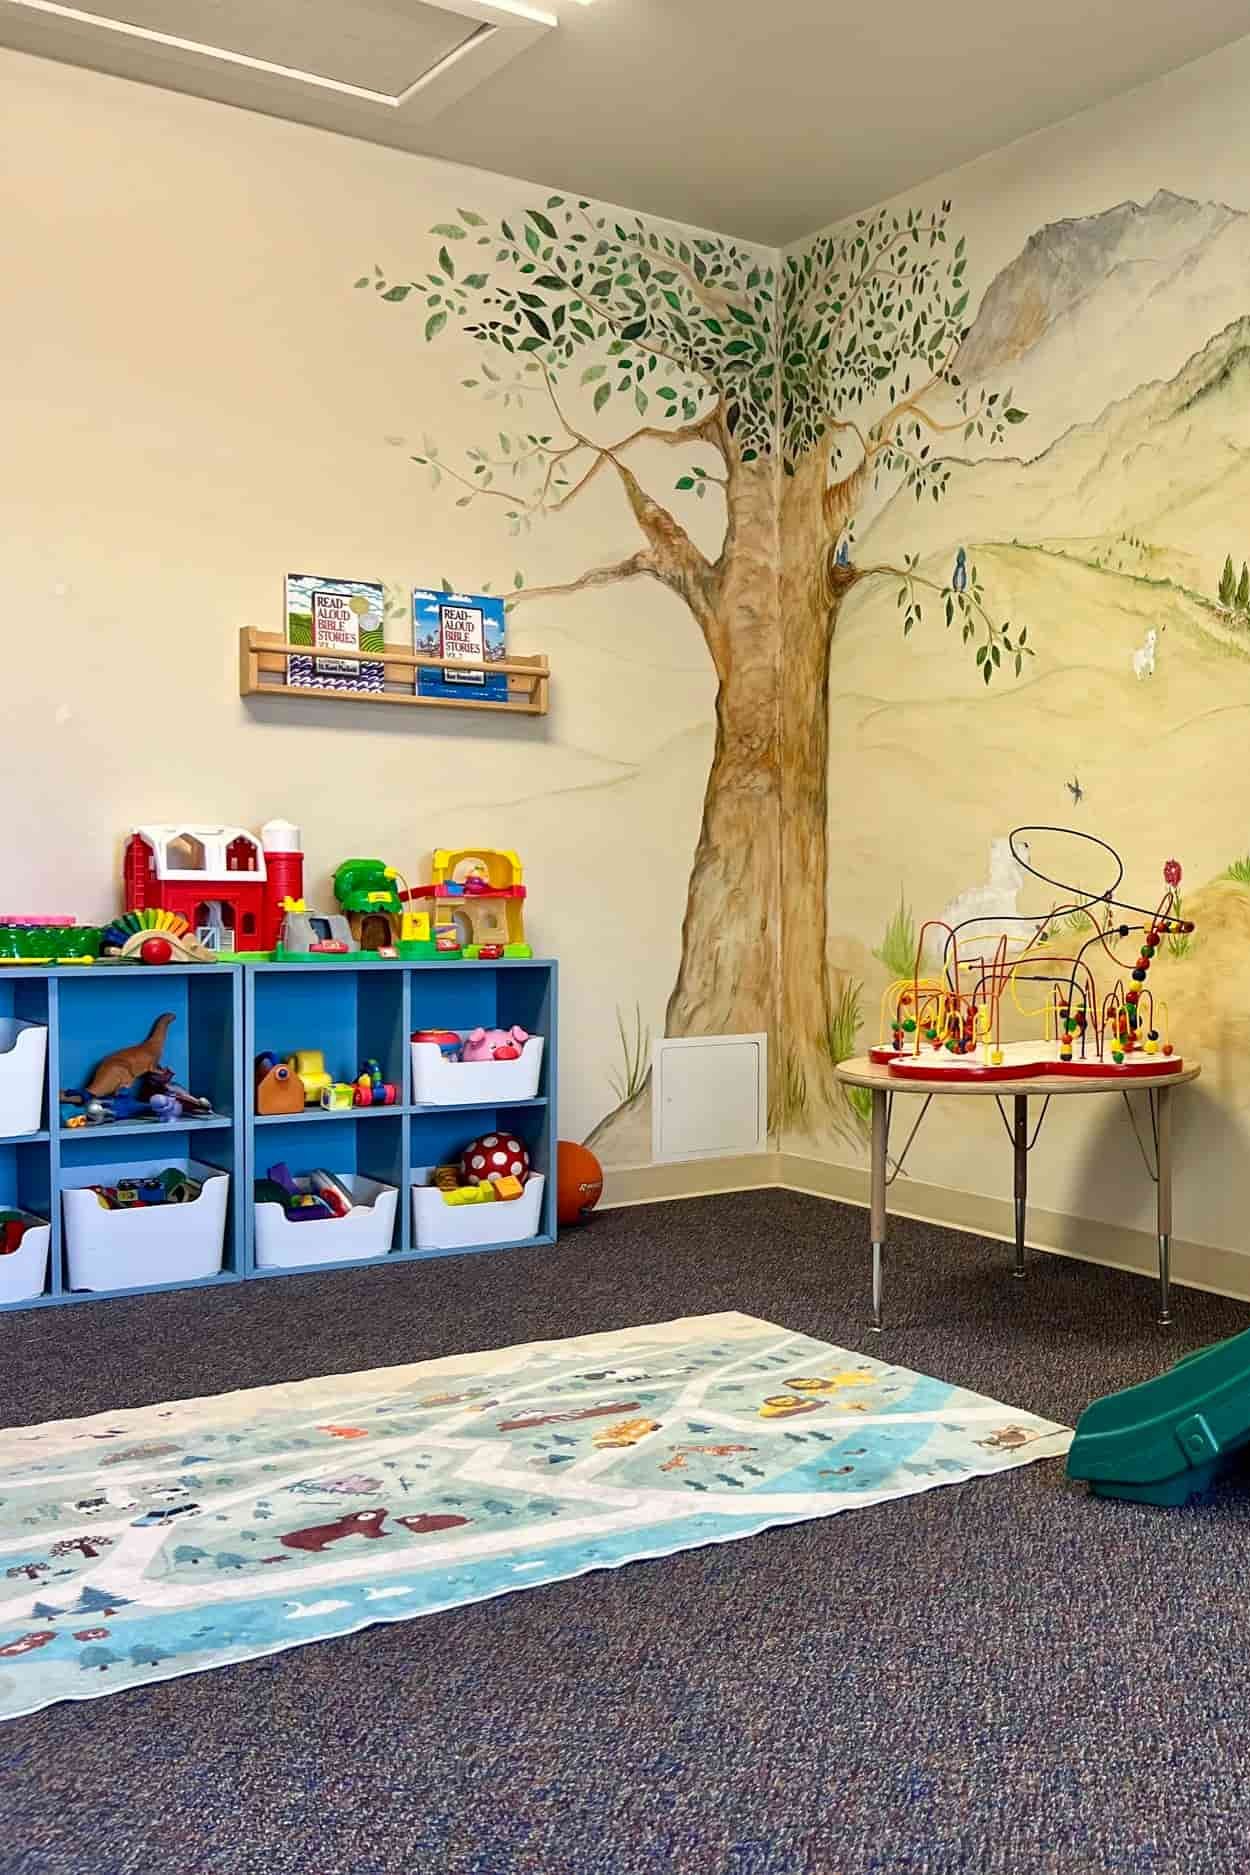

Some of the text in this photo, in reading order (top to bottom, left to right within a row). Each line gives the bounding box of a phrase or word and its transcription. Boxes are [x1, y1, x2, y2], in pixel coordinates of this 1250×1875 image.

[317, 596, 348, 609] READ-
[318, 608, 351, 621] ALOUD
[444, 609, 472, 620] READ-
[318, 619, 345, 632] BIBLE
[446, 620, 475, 632] ALOUD
[318, 631, 357, 643] STORIES
[446, 631, 470, 641] BIBLE
[446, 641, 480, 653] STORIES
